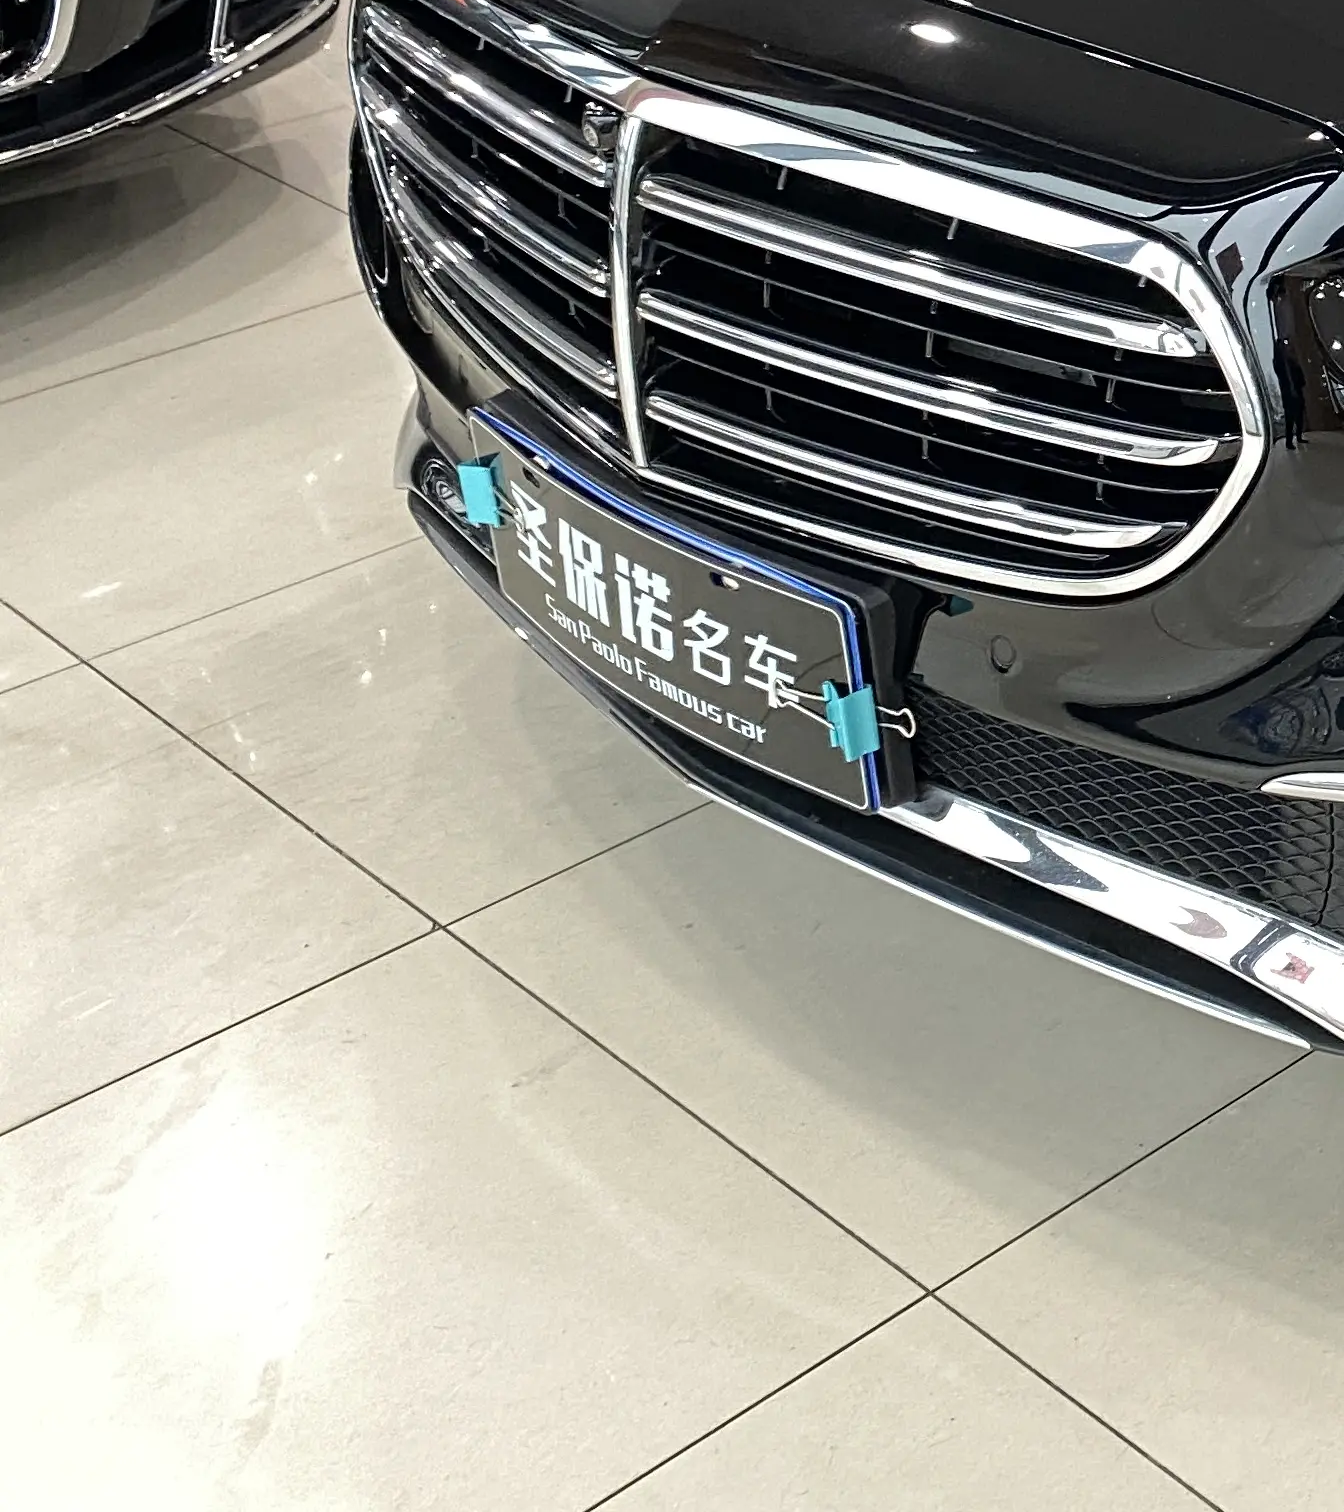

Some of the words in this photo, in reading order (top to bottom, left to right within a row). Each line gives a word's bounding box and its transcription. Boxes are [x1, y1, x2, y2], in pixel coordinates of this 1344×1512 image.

[545, 592, 578, 638] San
[577, 620, 634, 677] Paolo
[633, 654, 724, 727] Famous
[726, 711, 767, 744] car
